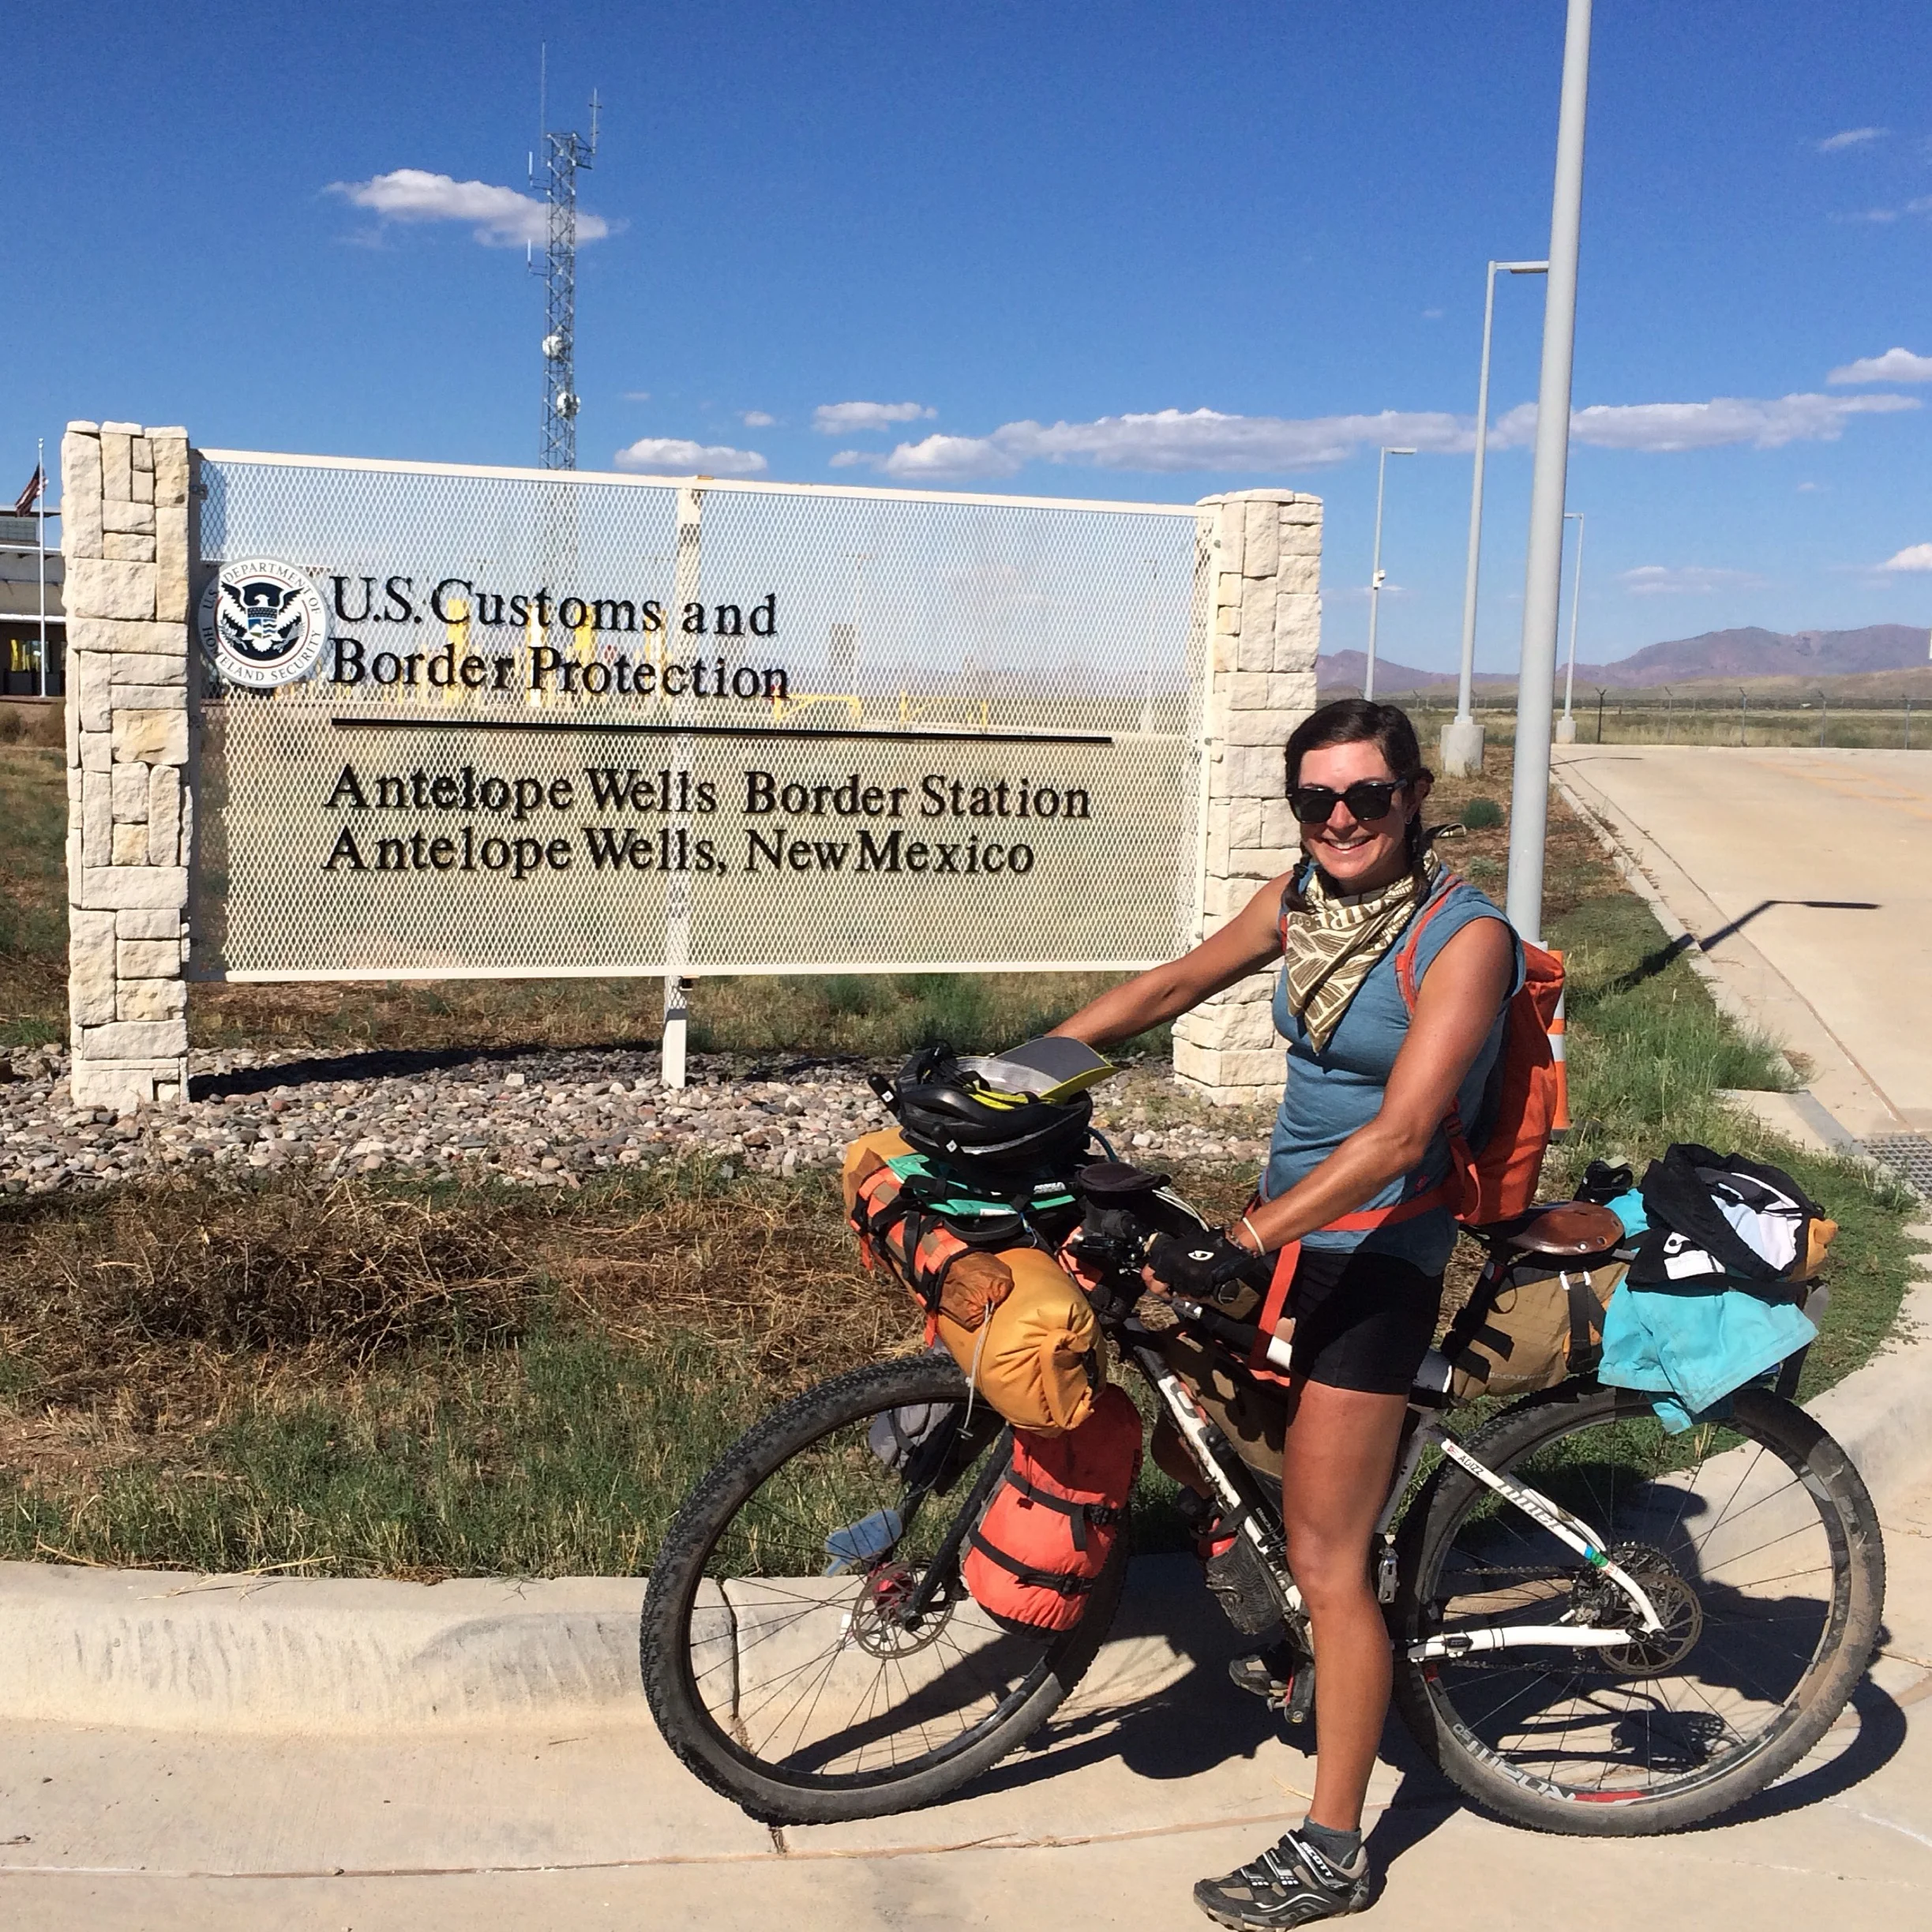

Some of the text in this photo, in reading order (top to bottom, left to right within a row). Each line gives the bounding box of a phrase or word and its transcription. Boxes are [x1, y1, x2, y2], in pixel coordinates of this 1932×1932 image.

[223, 561, 313, 596] DEPARTMENT
[308, 597, 322, 615] OF
[329, 576, 778, 636] U.S. Customs and
[201, 627, 321, 682] HOMELAND SECURITY
[328, 637, 790, 699] Border Protection
[324, 763, 1091, 820] Antelope Wells Border Station
[325, 825, 1034, 879] Antelope Wells, New Mexico
[1299, 1841, 1334, 1878] SCOTT
